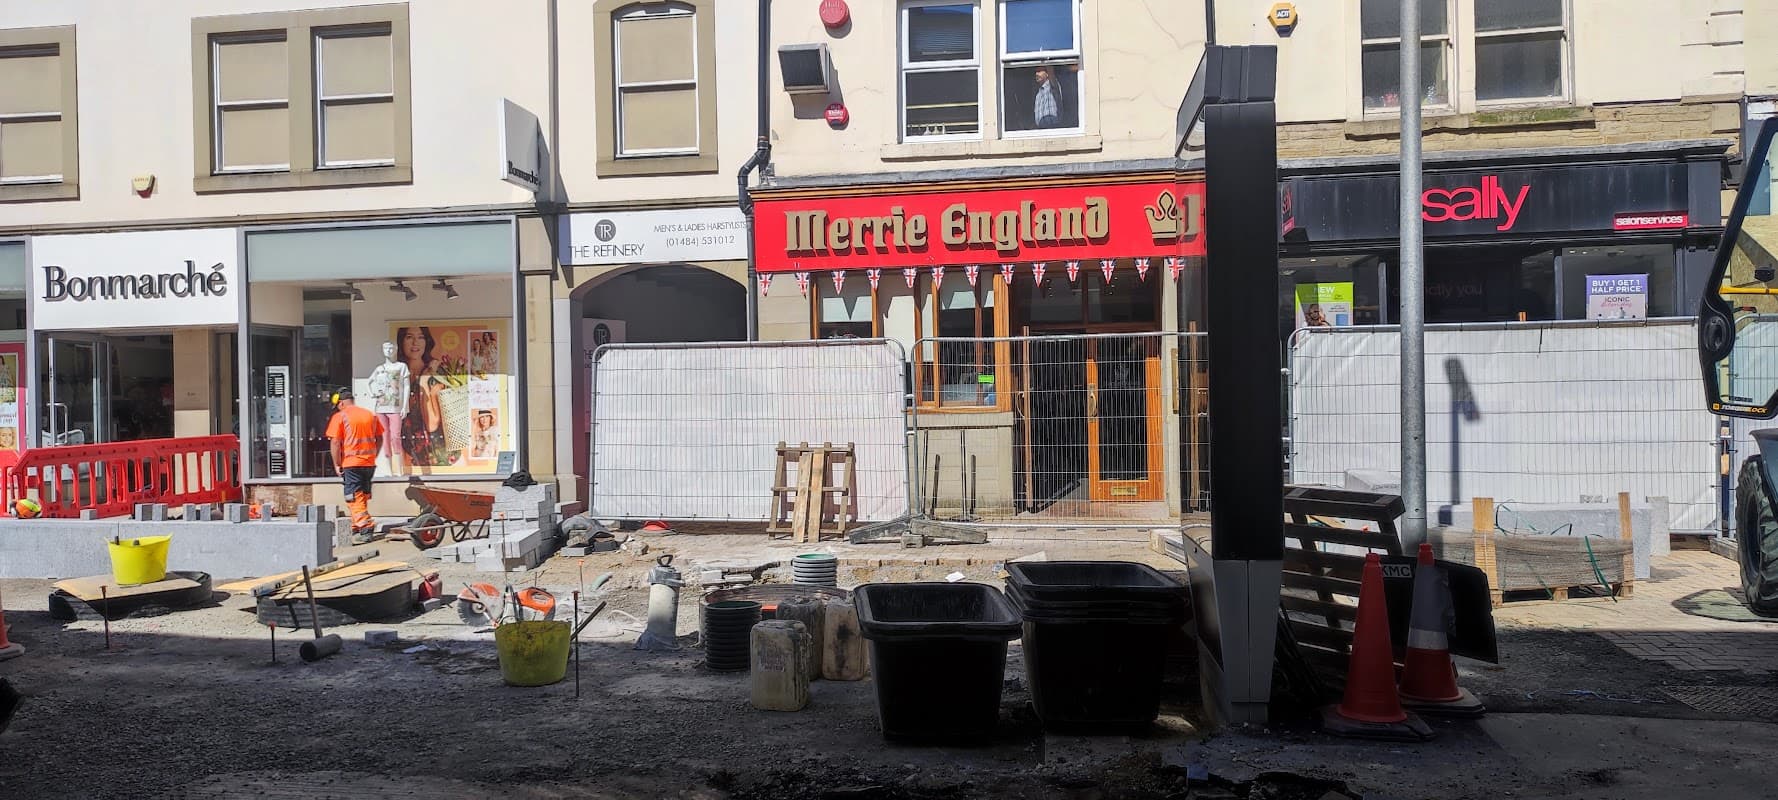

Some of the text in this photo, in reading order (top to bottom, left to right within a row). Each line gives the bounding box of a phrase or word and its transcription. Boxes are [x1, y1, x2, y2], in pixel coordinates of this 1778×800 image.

[1277, 10, 1289, 18] ADT
[1421, 175, 1531, 231] sally
[784, 196, 1109, 257] Merrie England
[1615, 215, 1683, 226] salonservices
[653, 224, 677, 233] MEN'S
[678, 224, 683, 232] &
[684, 223, 706, 231] LADIES
[666, 235, 735, 248] (01484) 531012
[568, 243, 646, 258] THE REFINERY
[41, 260, 227, 302] Bonmarché
